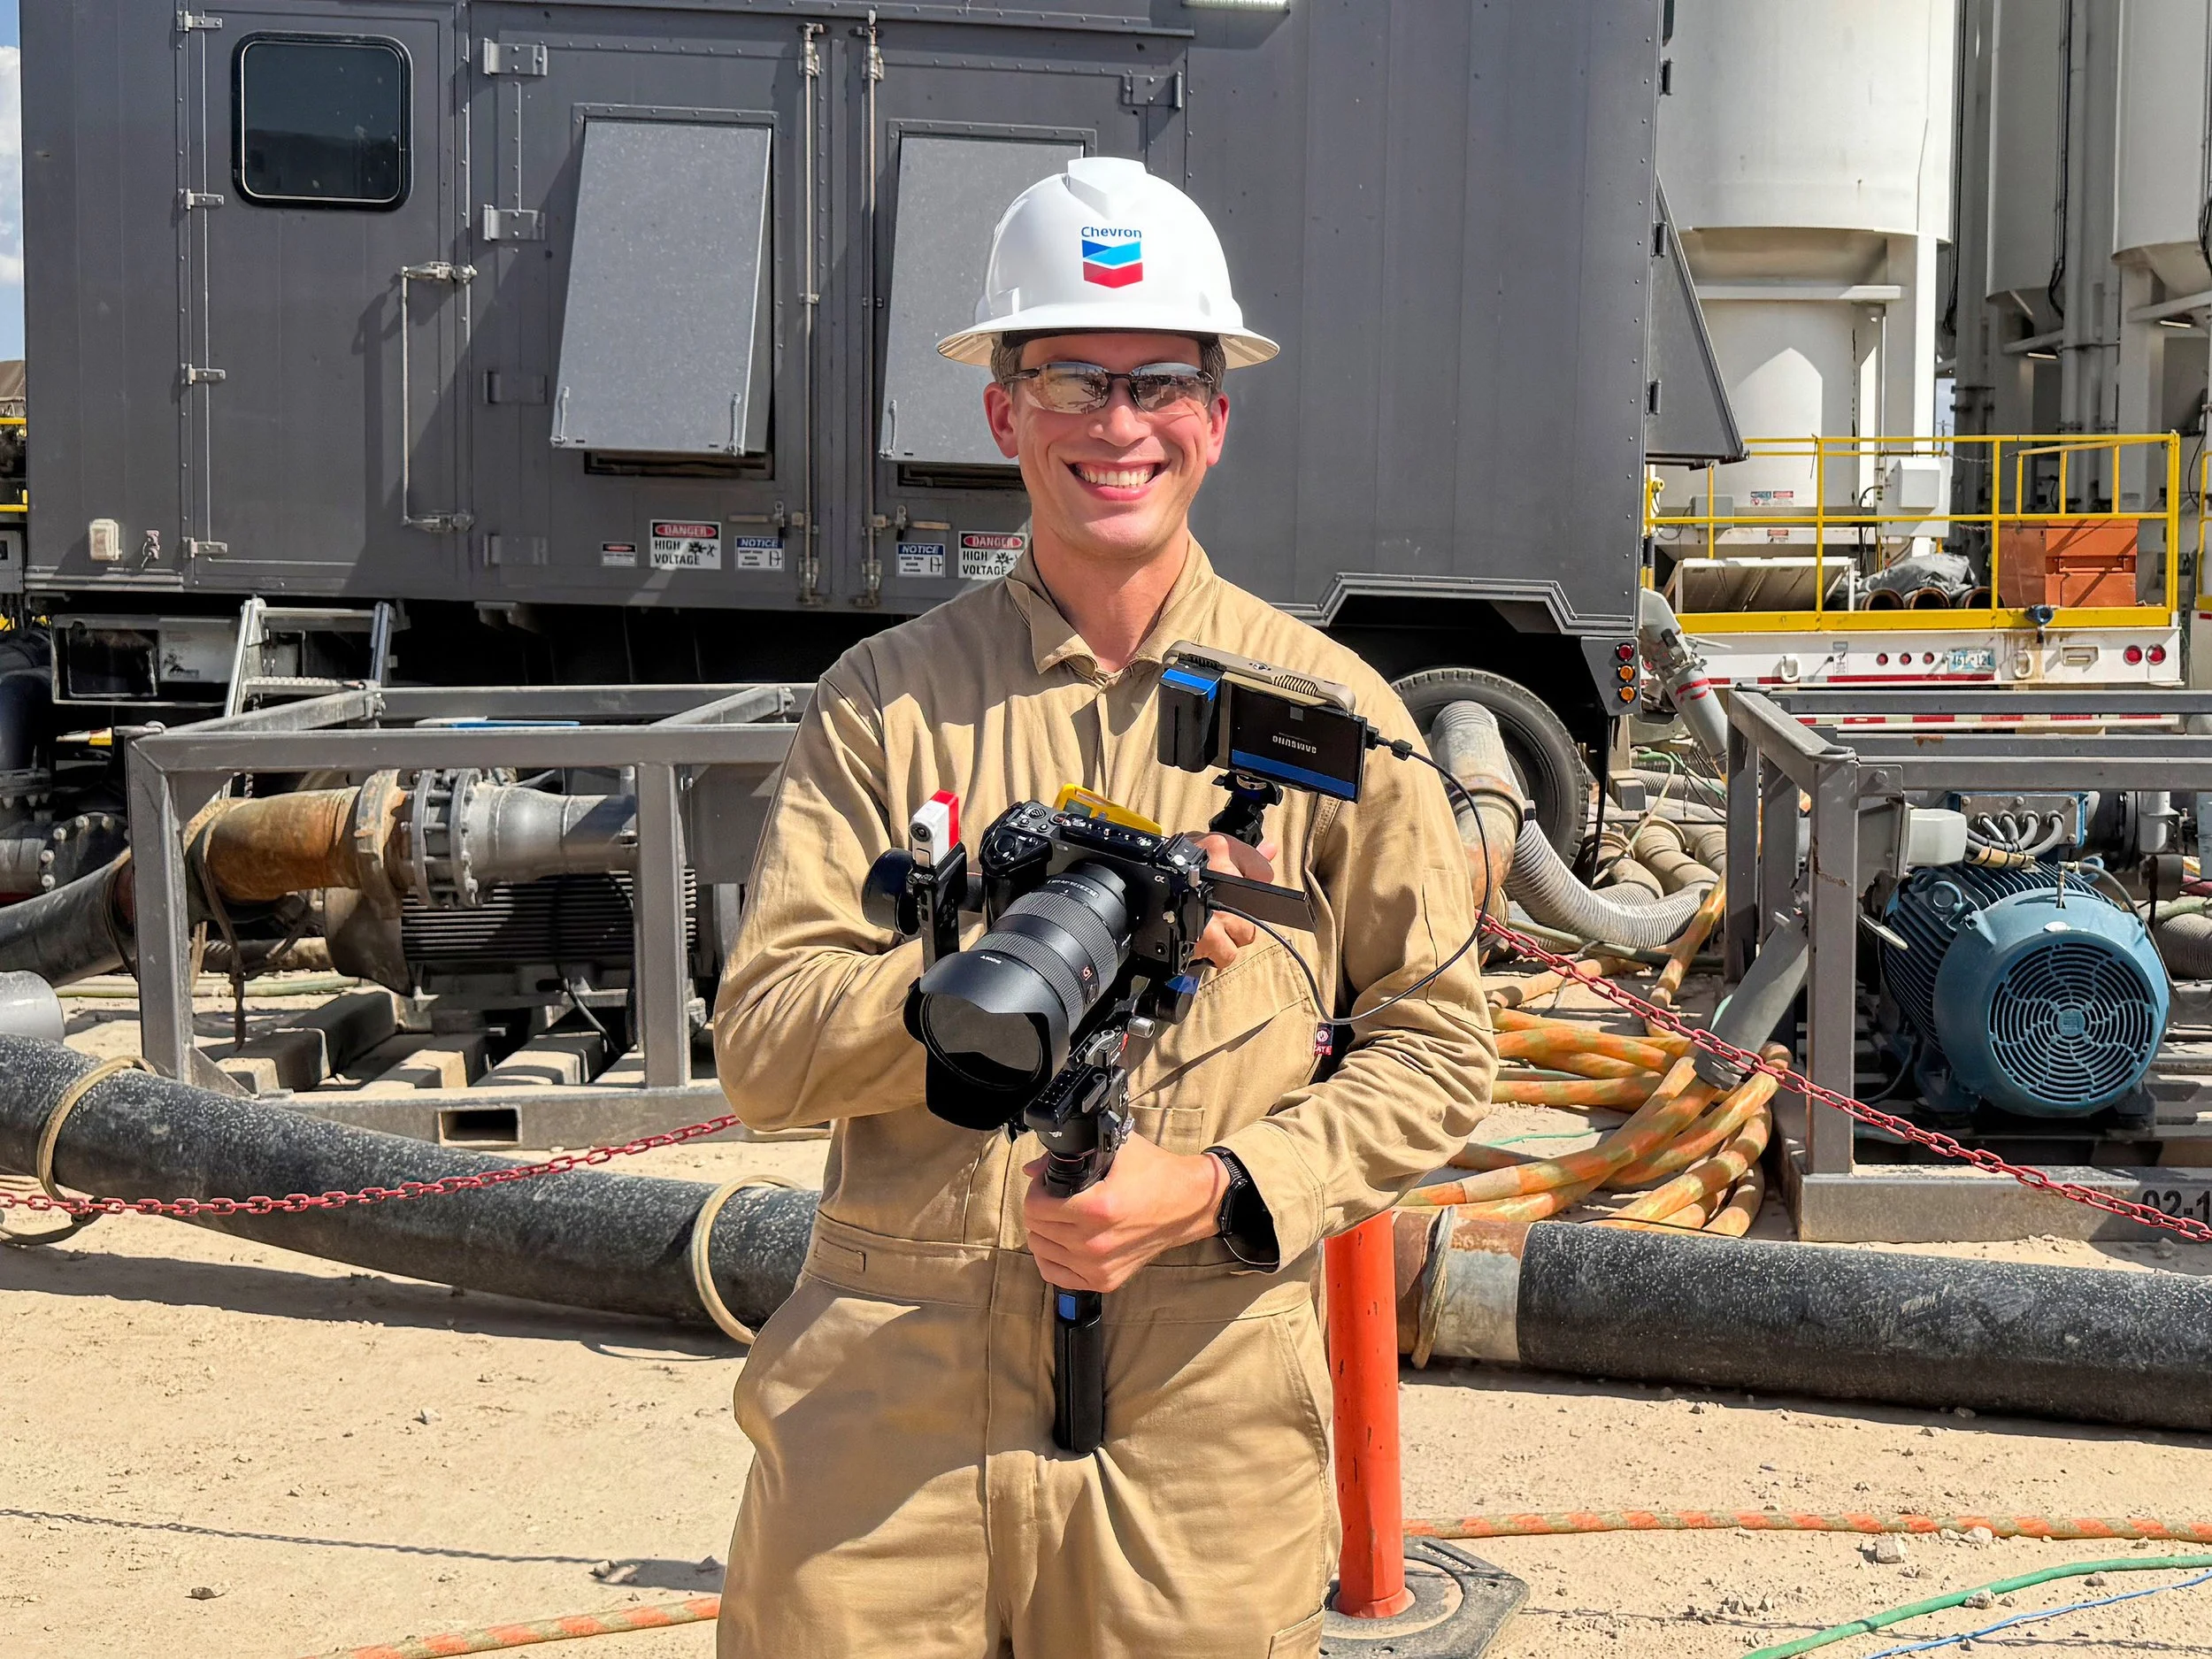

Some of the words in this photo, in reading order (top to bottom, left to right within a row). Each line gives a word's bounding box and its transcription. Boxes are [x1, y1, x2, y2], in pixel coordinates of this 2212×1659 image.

[1081, 227, 1141, 238] Chevron
[664, 524, 708, 536] DANGER
[655, 540, 680, 550] HIGH
[740, 538, 779, 548] NOTICE
[972, 535, 1014, 548] DANGER
[902, 545, 940, 554] NOTICE
[655, 554, 701, 565] VOLTAGE
[963, 550, 987, 561] HIGH
